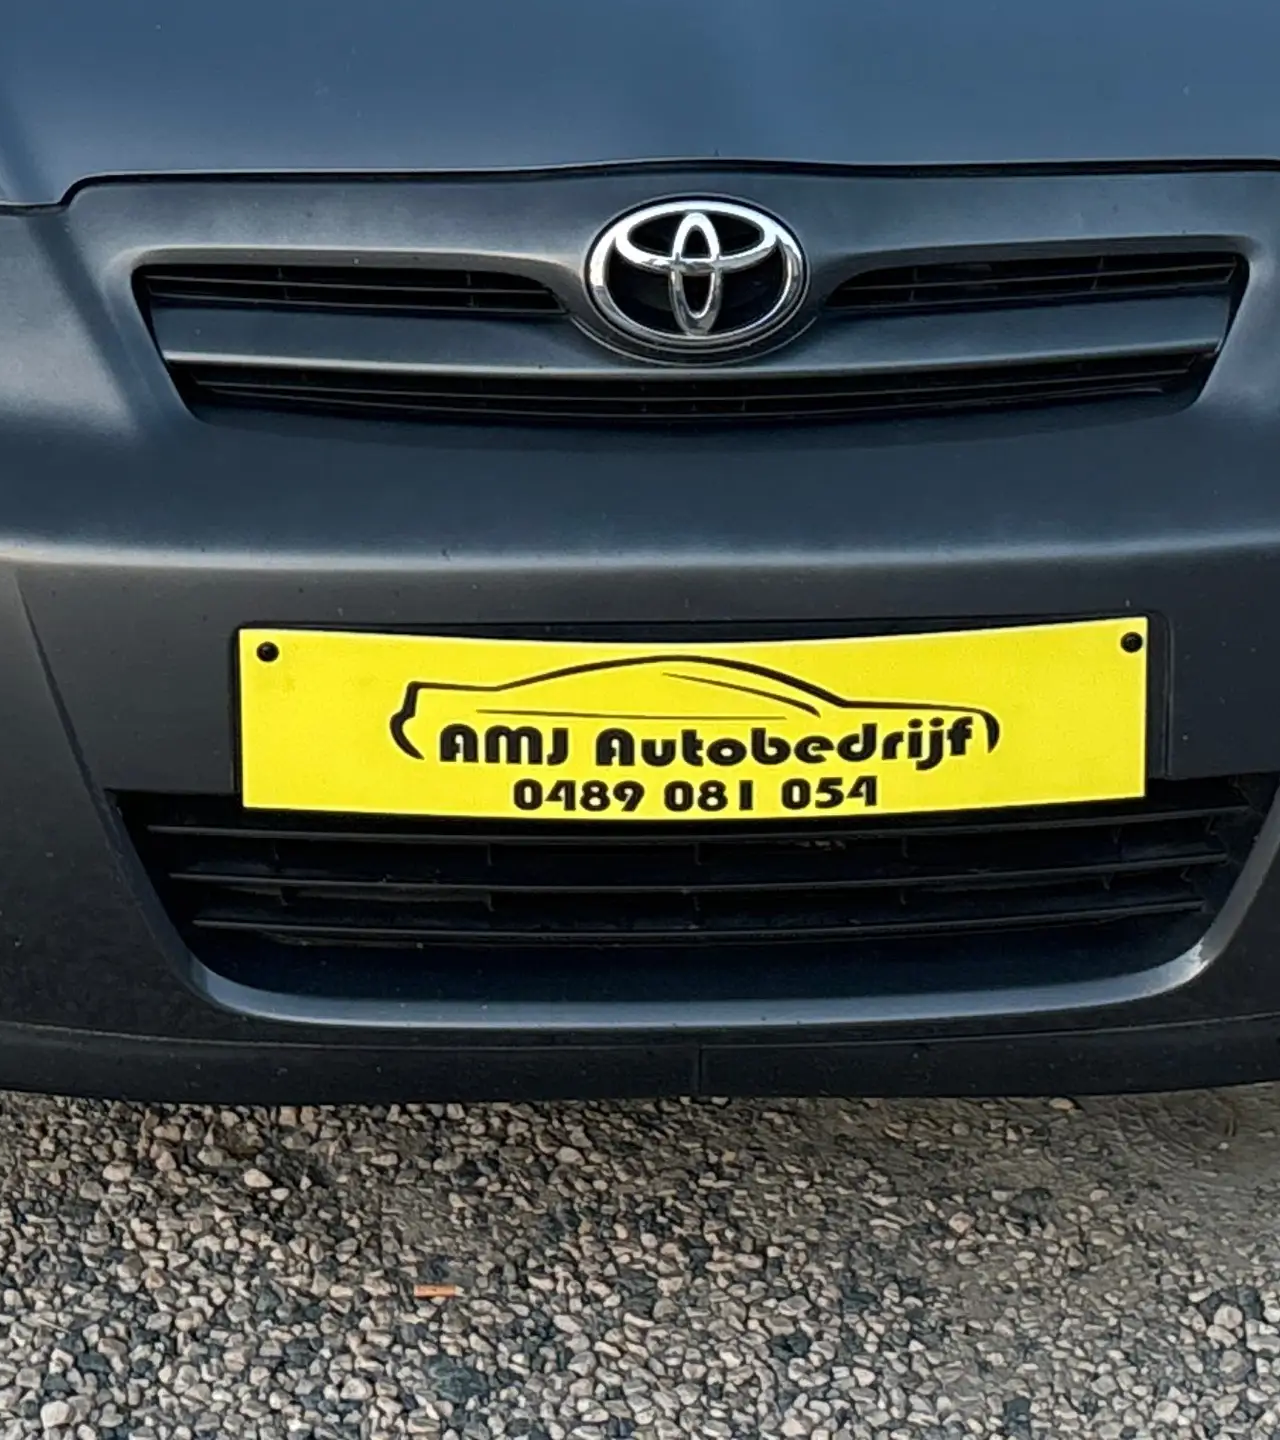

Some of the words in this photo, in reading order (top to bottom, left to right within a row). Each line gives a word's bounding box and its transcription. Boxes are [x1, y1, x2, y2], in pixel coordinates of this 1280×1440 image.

[439, 723, 569, 766] AMJ
[595, 716, 974, 771] Autobedrijf
[513, 778, 645, 812] 0489
[663, 779, 754, 812] 081
[781, 775, 878, 811] 054
